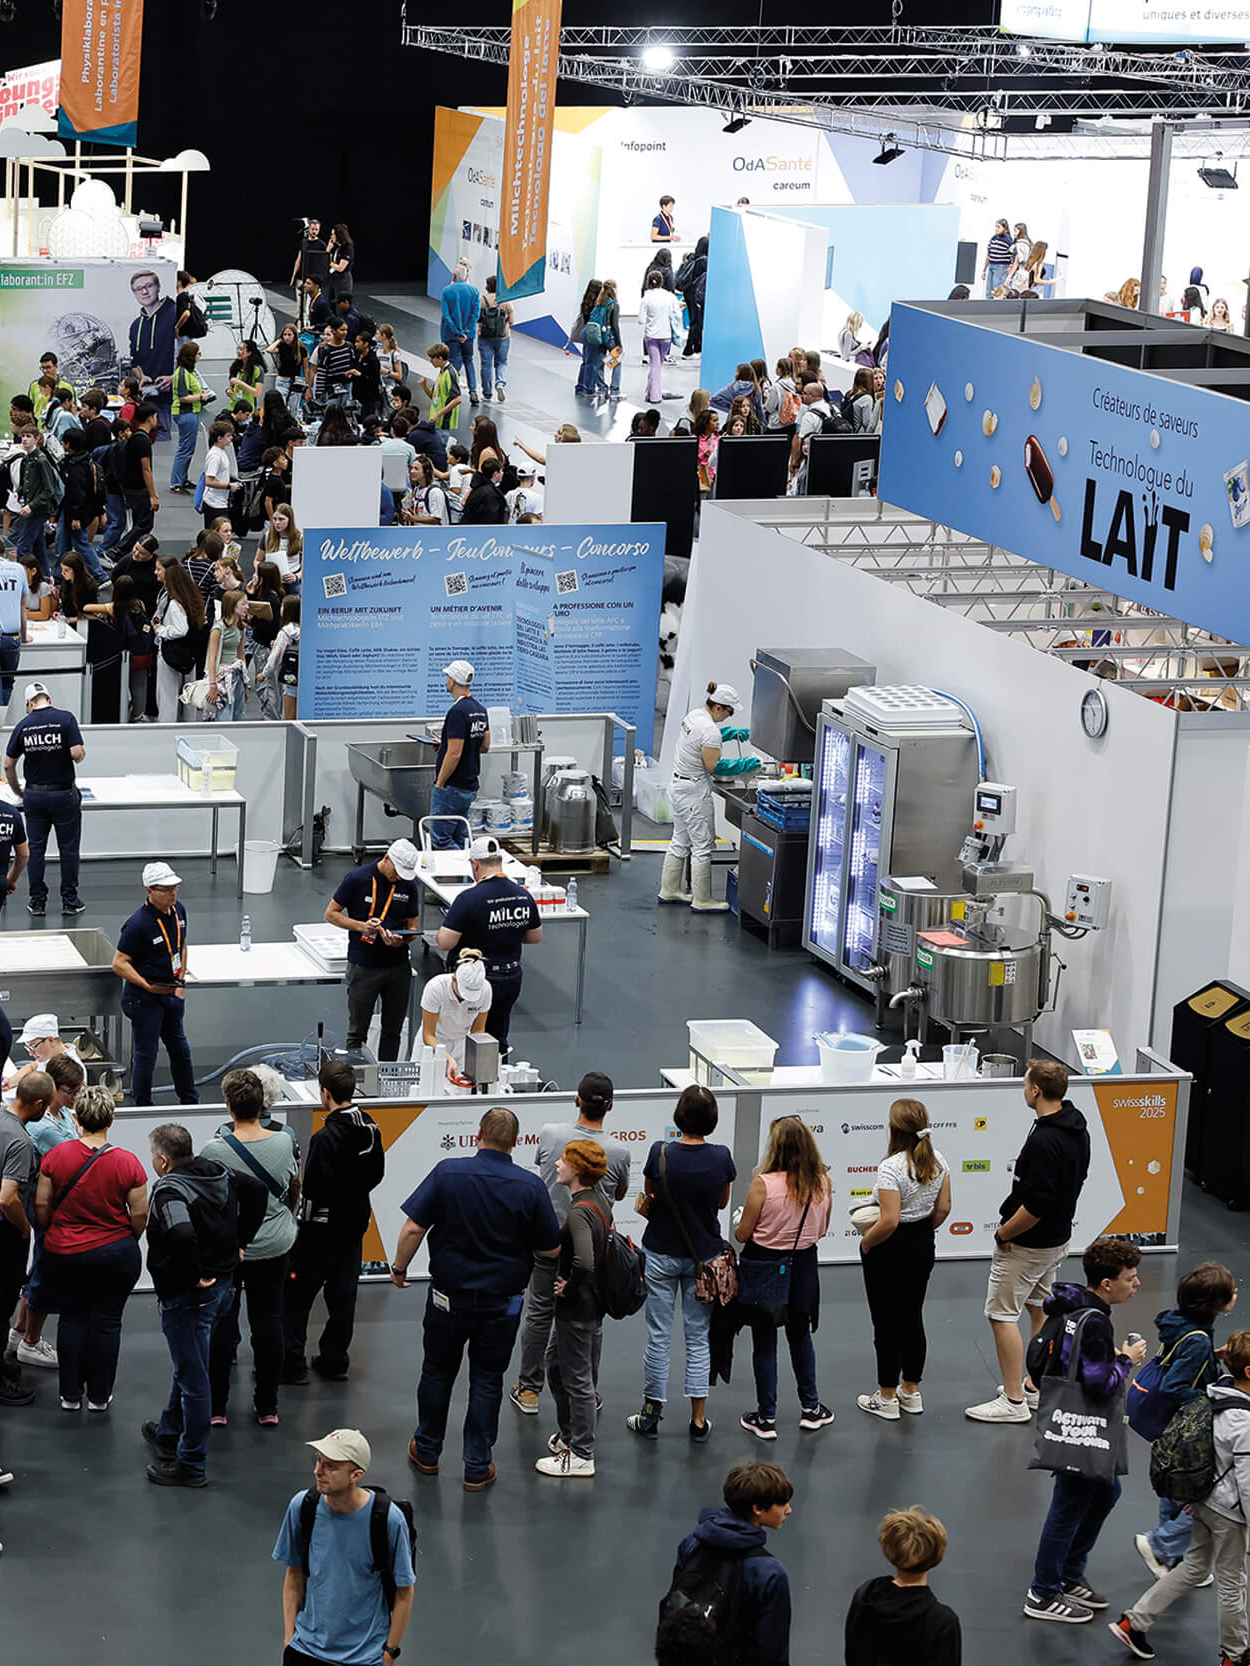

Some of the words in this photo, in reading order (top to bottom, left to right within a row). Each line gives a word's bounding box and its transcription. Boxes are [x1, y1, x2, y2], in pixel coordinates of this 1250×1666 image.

[100, 10, 107, 26] en
[1143, 10, 1187, 22] uniques
[1190, 11, 1201, 20] et
[1204, 9, 1250, 20] diverses
[110, 13, 122, 103] Laboratorista
[94, 31, 107, 112] Laborantine
[537, 83, 548, 119] del
[510, 36, 530, 235] Milchtechnologe
[732, 156, 813, 172] OdASanté
[773, 180, 811, 191] careum
[56, 273, 74, 286] EFZ
[1092, 388, 1141, 421] Créateurs
[1143, 403, 1157, 426] de
[1159, 411, 1199, 439] saveurs
[1089, 439, 1172, 492] Technologue
[1175, 469, 1194, 498] du
[1080, 478, 1191, 591] LAIT
[320, 538, 424, 563] Wettbewerb
[576, 536, 650, 559] Concorso
[443, 604, 468, 612] MÉTIER
[559, 602, 605, 610] PROFESSIONE
[606, 601, 622, 609] CON
[23, 733, 62, 747] MILCH
[489, 906, 530, 924] MILCH
[1113, 1095, 1166, 1108] swissskills
[1139, 1107, 1166, 1119] 2025
[851, 1123, 885, 1131] swisscom
[459, 1135, 479, 1147] UB
[608, 1131, 647, 1141] GROS
[1052, 1409, 1108, 1428] ACTIVATE
[1061, 1425, 1097, 1438] YOUR
[1044, 1430, 1110, 1450] SUPERPOWER
